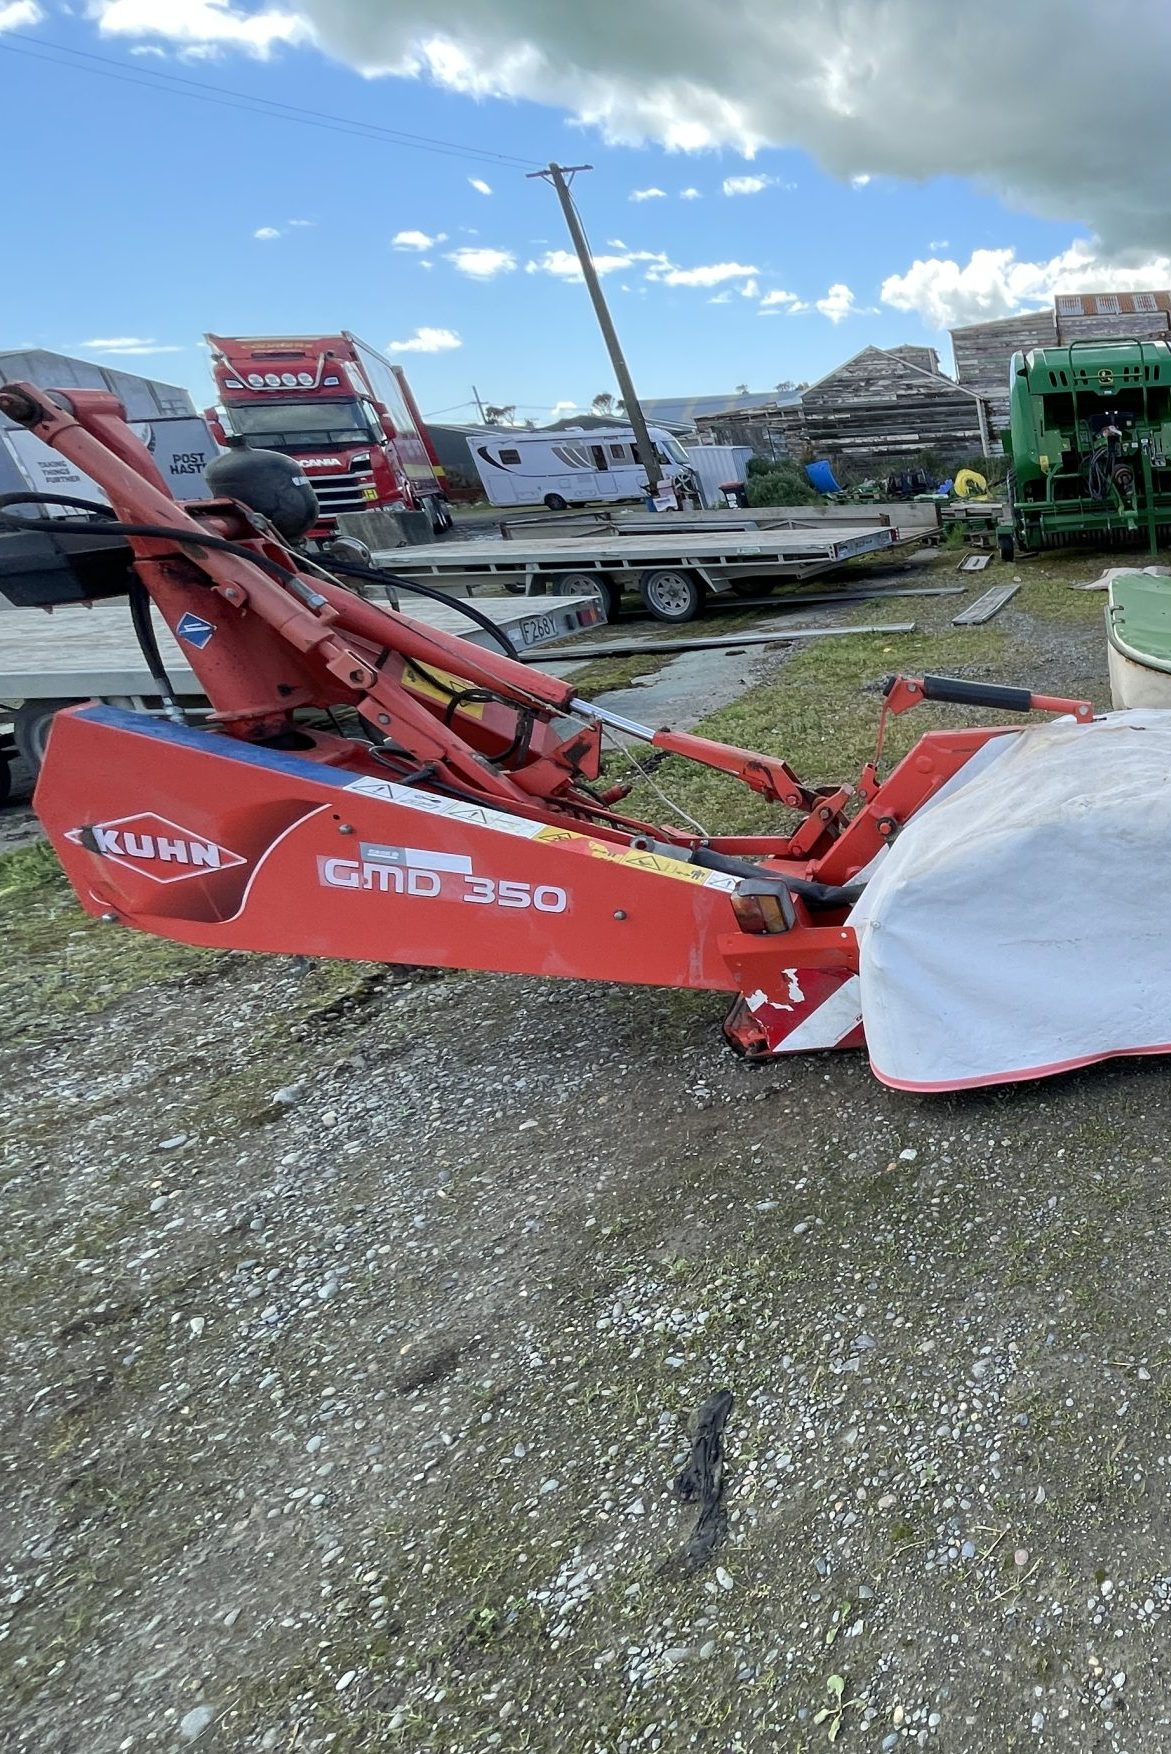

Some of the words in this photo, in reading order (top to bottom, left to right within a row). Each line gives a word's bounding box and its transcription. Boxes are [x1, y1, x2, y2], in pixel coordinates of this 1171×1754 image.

[172, 452, 205, 464] POST
[298, 458, 342, 468] CANIA
[523, 616, 556, 641] F268Y
[92, 827, 221, 868] KUHN
[324, 858, 441, 897] GMD
[463, 875, 567, 913] 350
